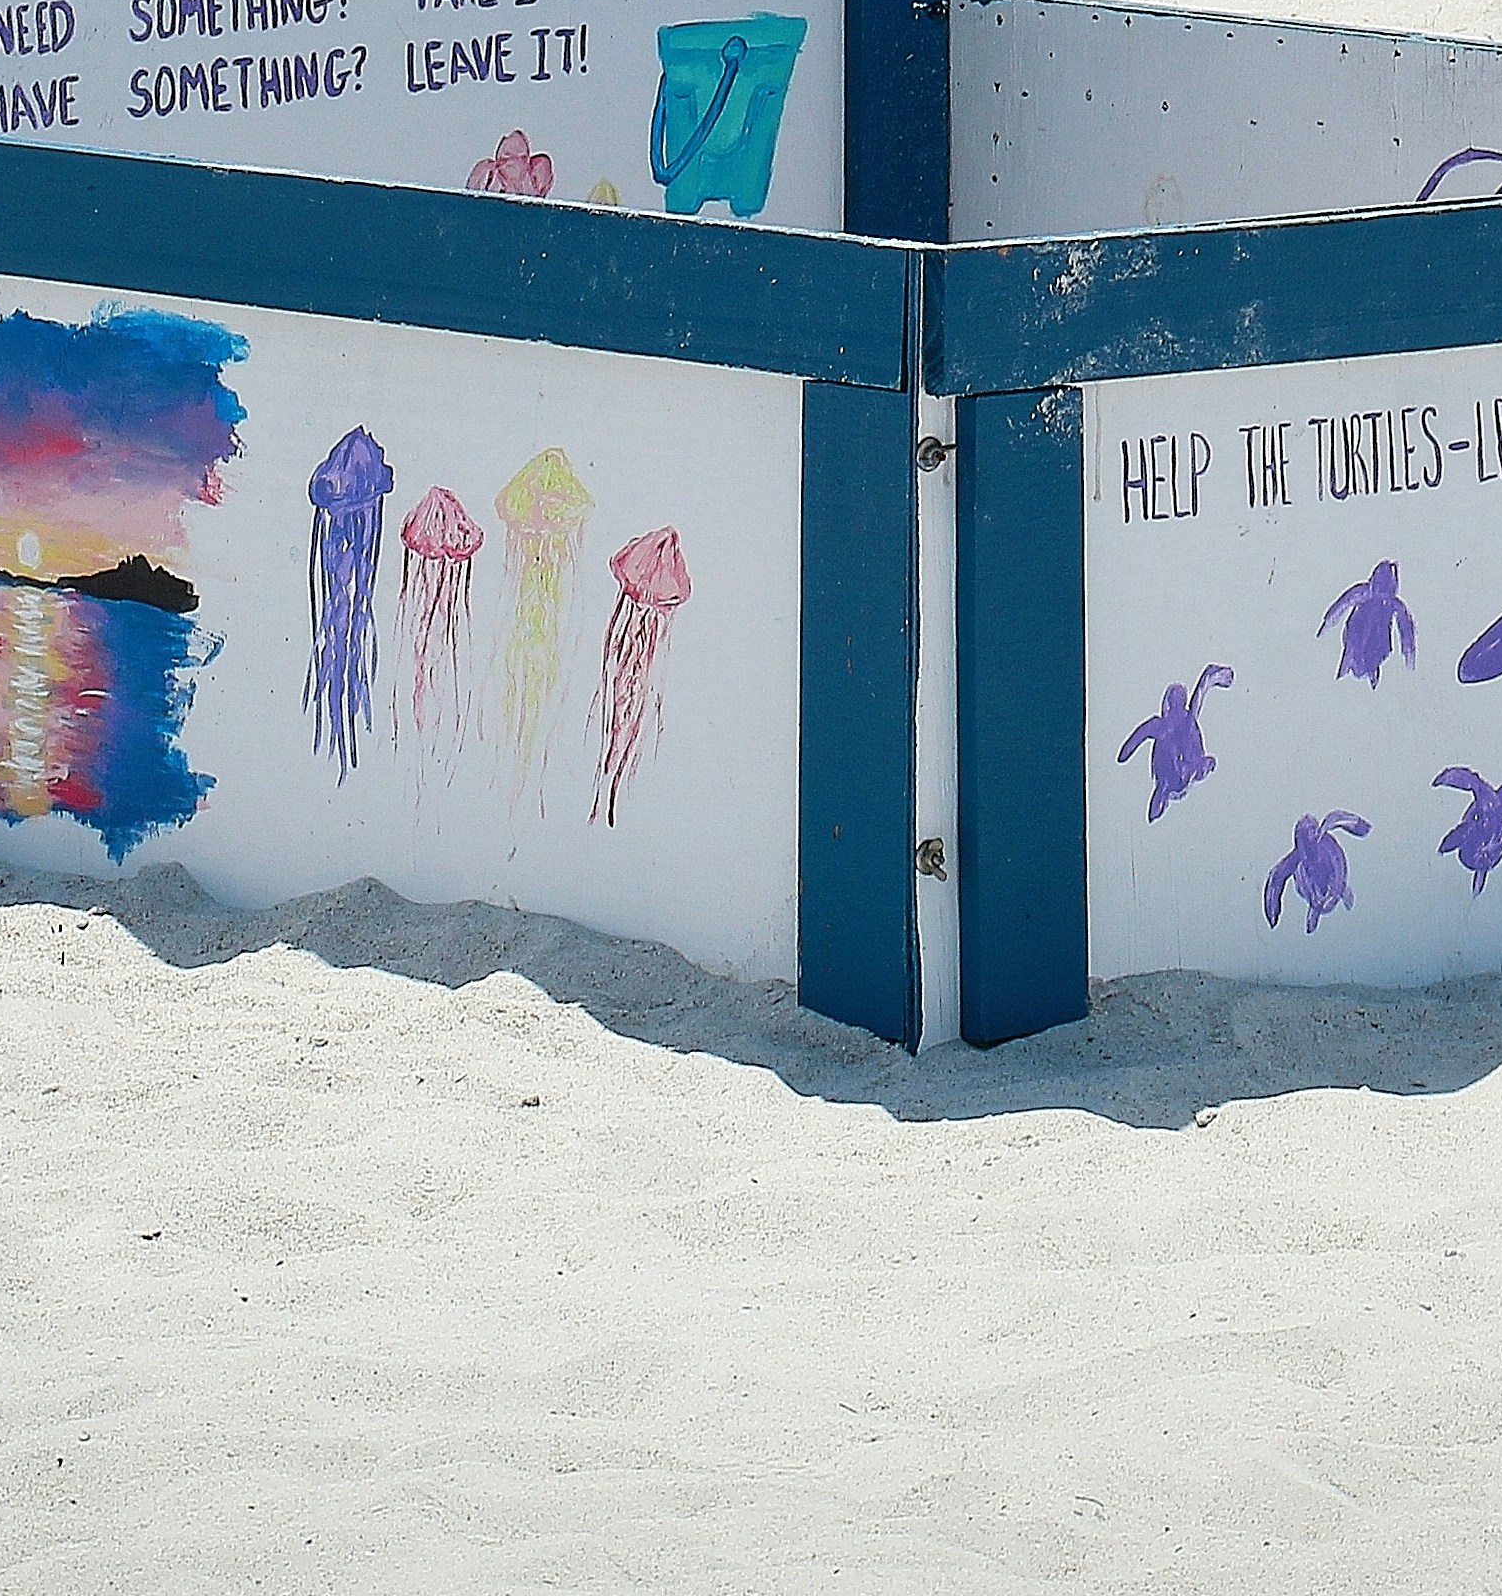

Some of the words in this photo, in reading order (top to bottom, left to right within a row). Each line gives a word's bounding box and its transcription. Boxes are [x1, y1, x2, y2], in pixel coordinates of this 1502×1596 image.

[126, 46, 367, 119] SOMETHING?
[406, 32, 517, 94] LEAVE
[530, 23, 588, 82] IT!
[1121, 432, 1211, 524] HELP
[1238, 422, 1293, 509] THE
